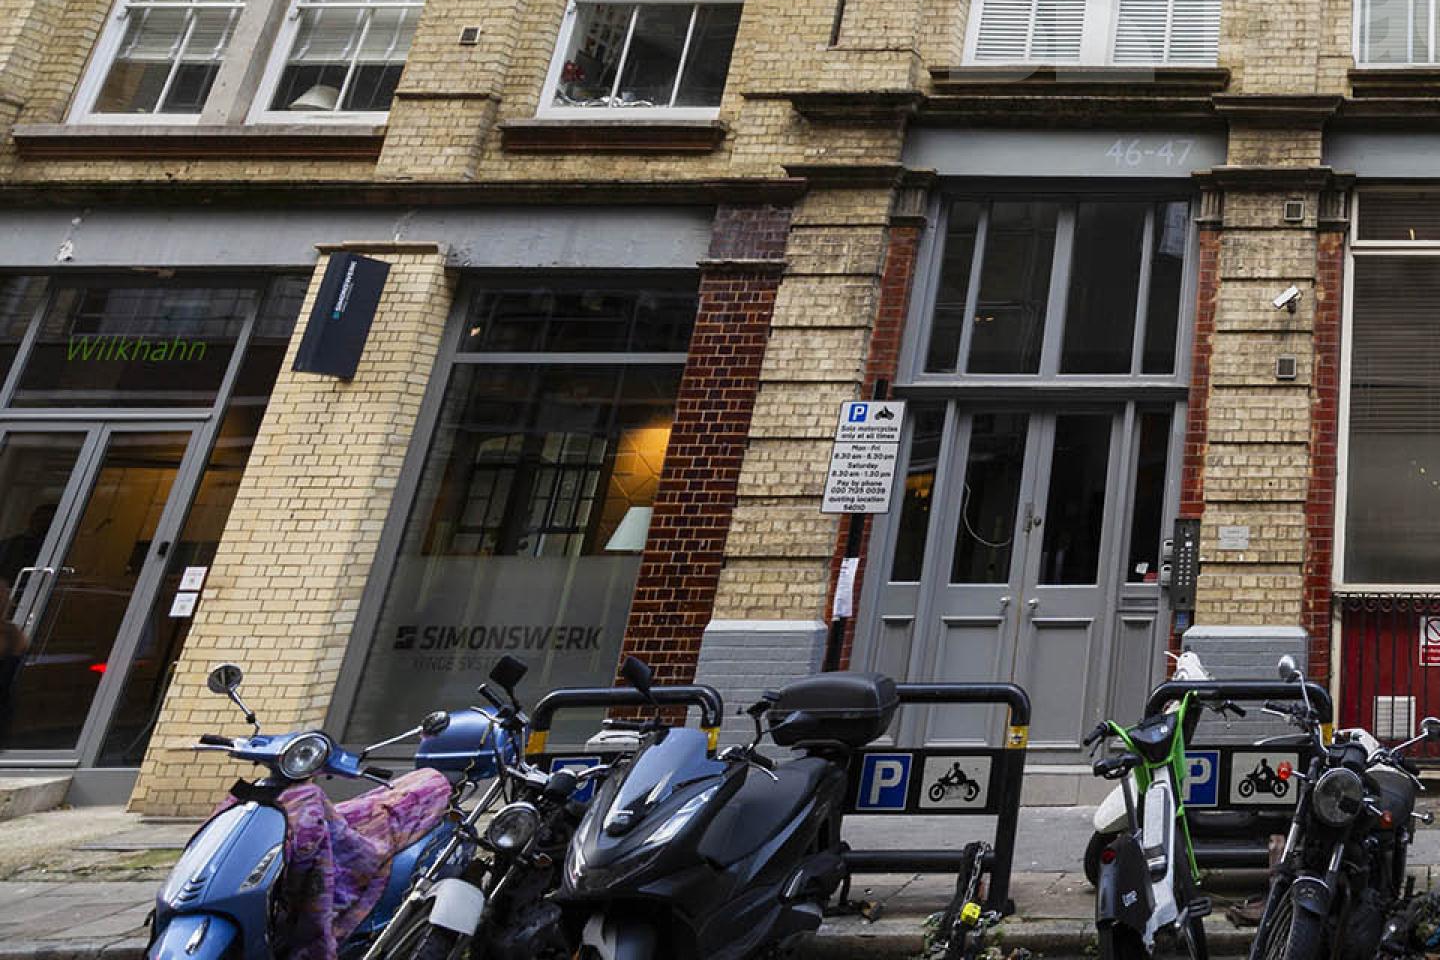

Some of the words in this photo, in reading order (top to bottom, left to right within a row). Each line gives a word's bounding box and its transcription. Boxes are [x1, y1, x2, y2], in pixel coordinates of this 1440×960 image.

[1105, 139, 1195, 167] 46-47
[66, 335, 207, 361] Wilkhahn
[857, 425, 898, 433] motorcycles
[419, 625, 604, 651] SIMONSWERK
[869, 760, 904, 805] P
[1183, 756, 1212, 802] P
